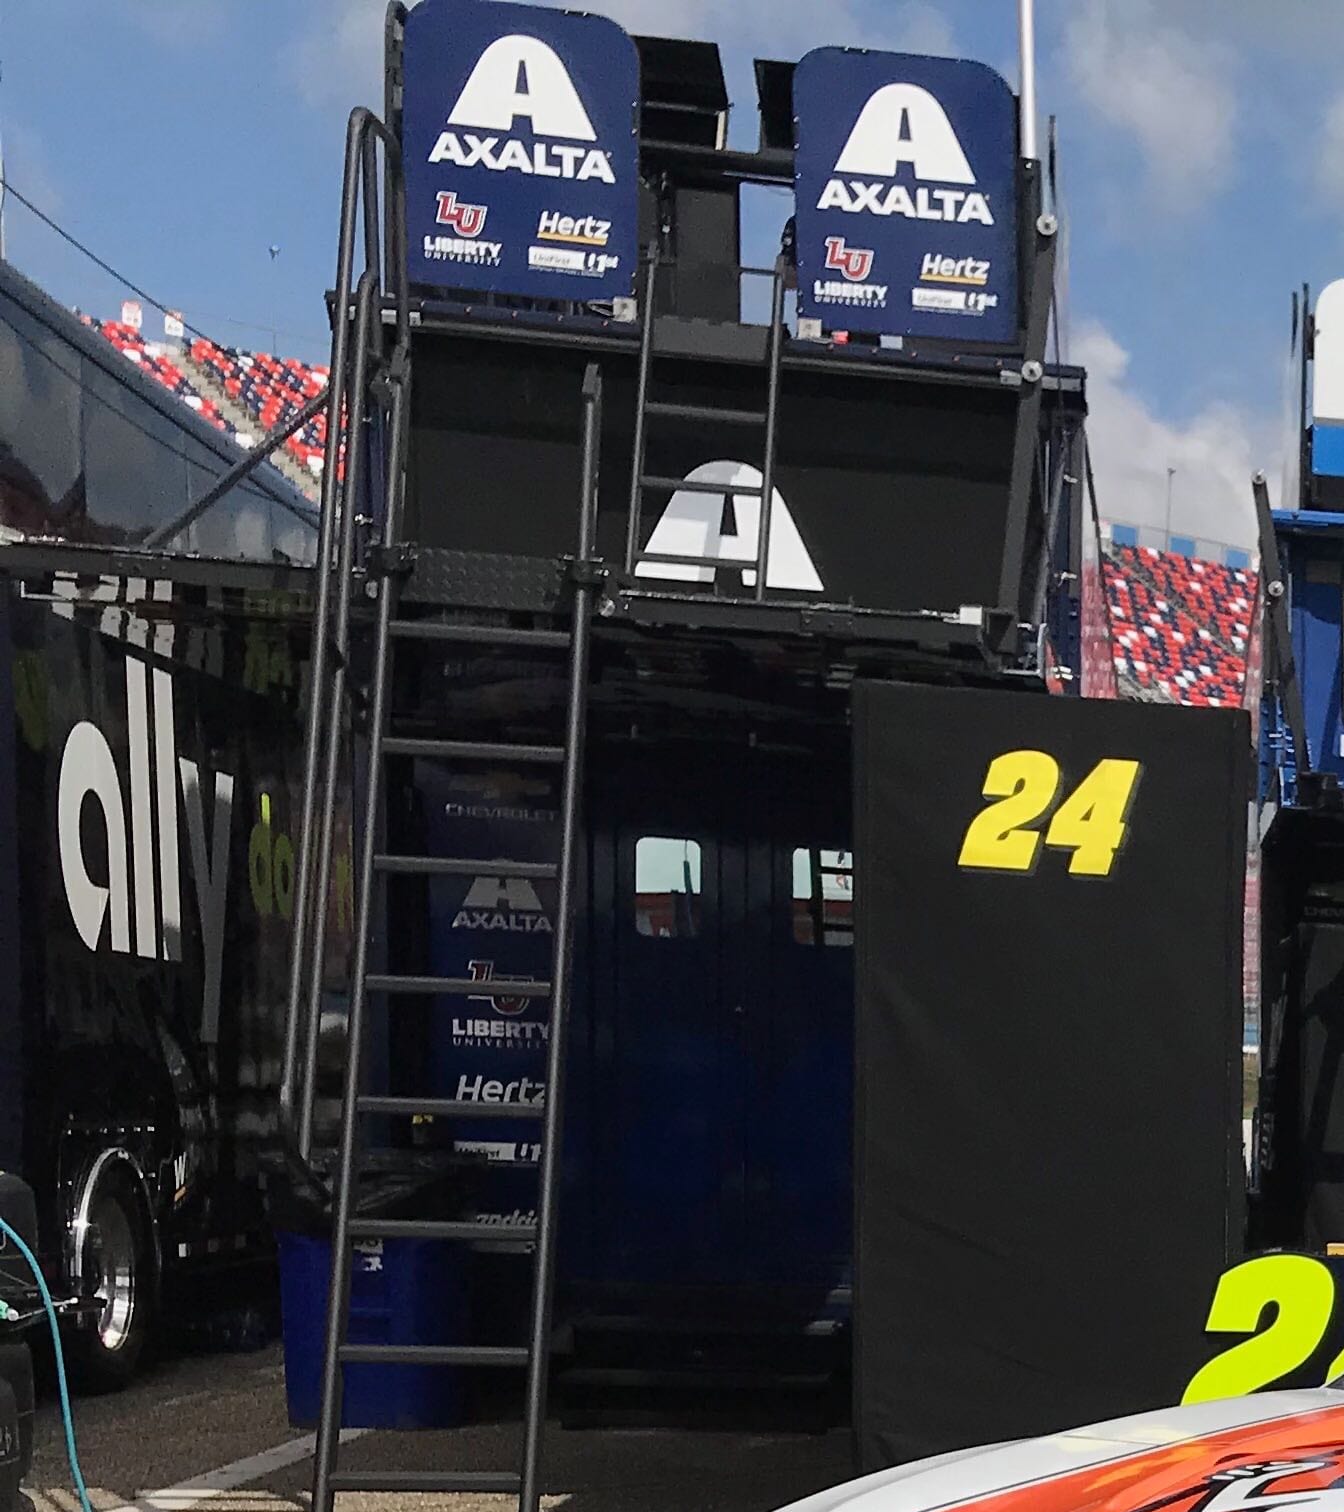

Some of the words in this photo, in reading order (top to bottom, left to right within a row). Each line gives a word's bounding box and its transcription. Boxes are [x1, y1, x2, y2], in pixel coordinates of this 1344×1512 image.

[427, 131, 616, 184] AXALTA
[816, 178, 995, 225] AXALTA
[537, 211, 611, 239] Hertz
[424, 235, 503, 259] LIBERTY
[424, 250, 502, 267] UNIVERSITY
[921, 252, 990, 280] Hertz
[814, 280, 888, 301] LIBERTY
[957, 750, 1141, 876] 24
[58, 653, 234, 1044] ally
[451, 910, 553, 933] AXALTA
[452, 1018, 550, 1040] LIBERTY
